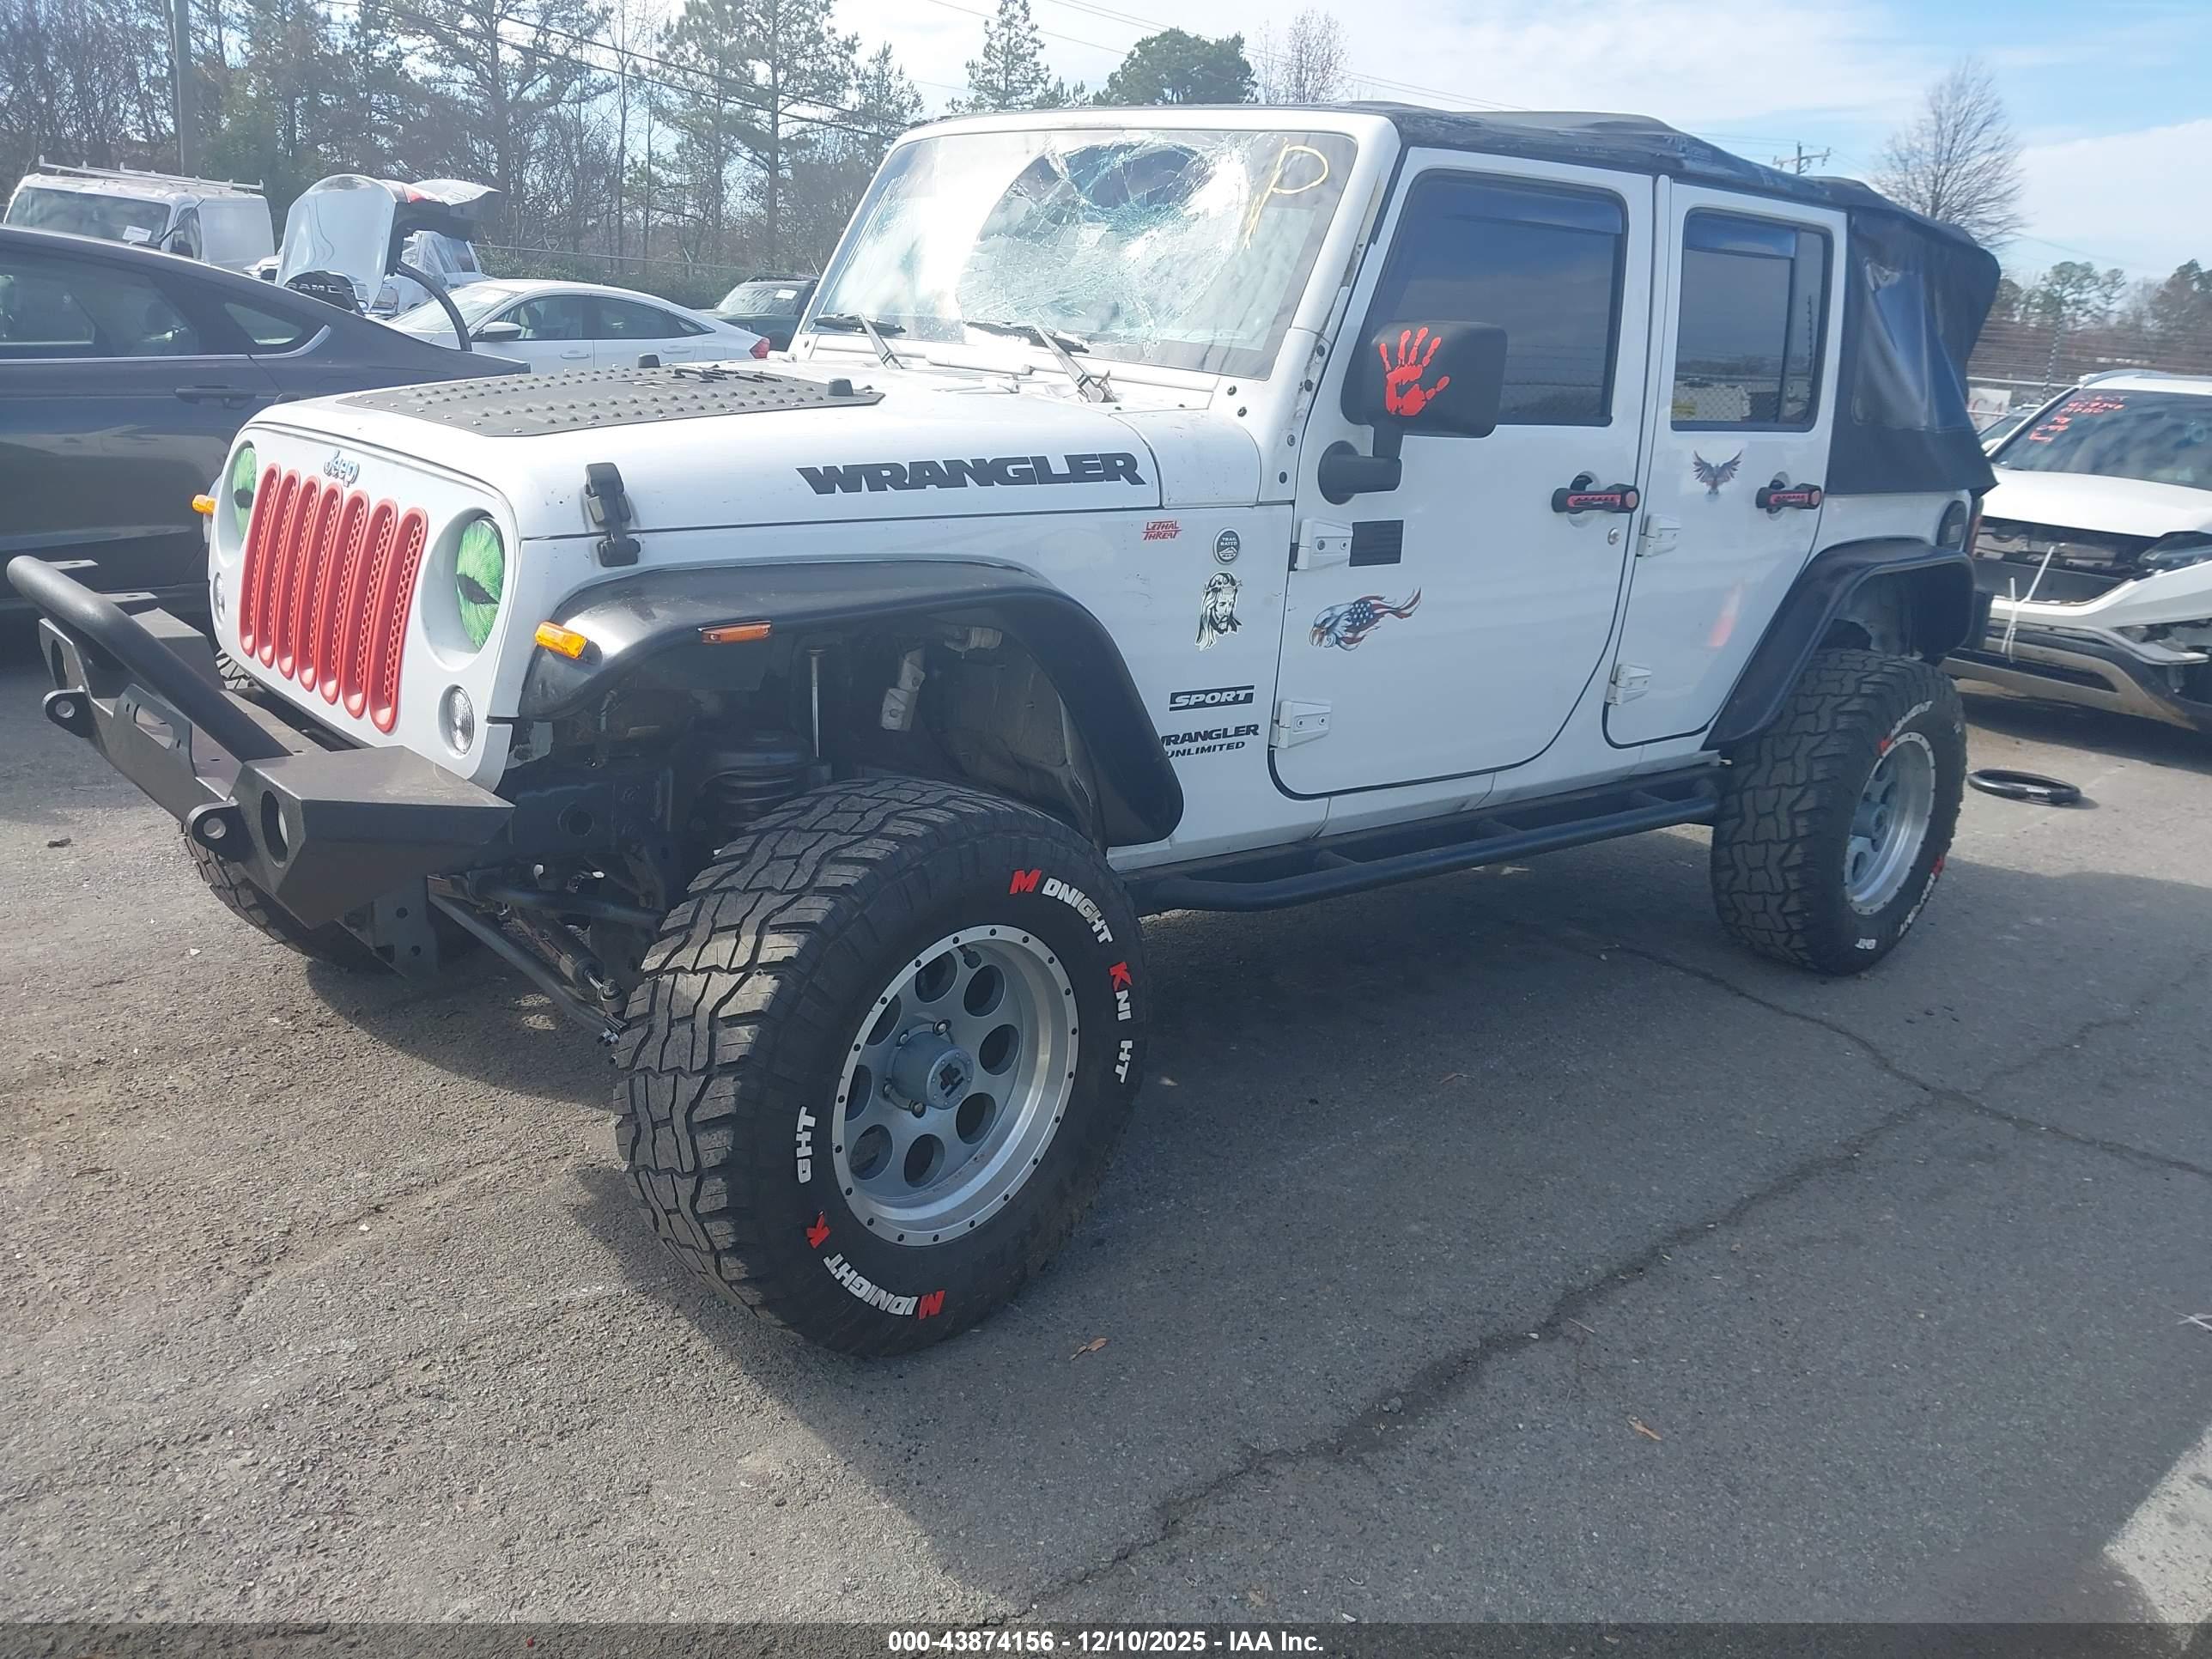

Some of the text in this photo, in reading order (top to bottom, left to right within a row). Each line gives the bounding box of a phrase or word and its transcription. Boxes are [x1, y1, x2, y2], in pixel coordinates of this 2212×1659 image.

[1243, 137, 1329, 250] P
[323, 449, 361, 488] Jeep
[796, 452, 1146, 495] WRANGLER
[1141, 529, 1182, 541] THREAT
[1146, 520, 1180, 531] LETHAL
[1170, 689, 1254, 708] SPORT
[1009, 868, 1134, 1085] MDNIGHT KNIHT
[822, 1251, 945, 1320] MIDNIGHT
